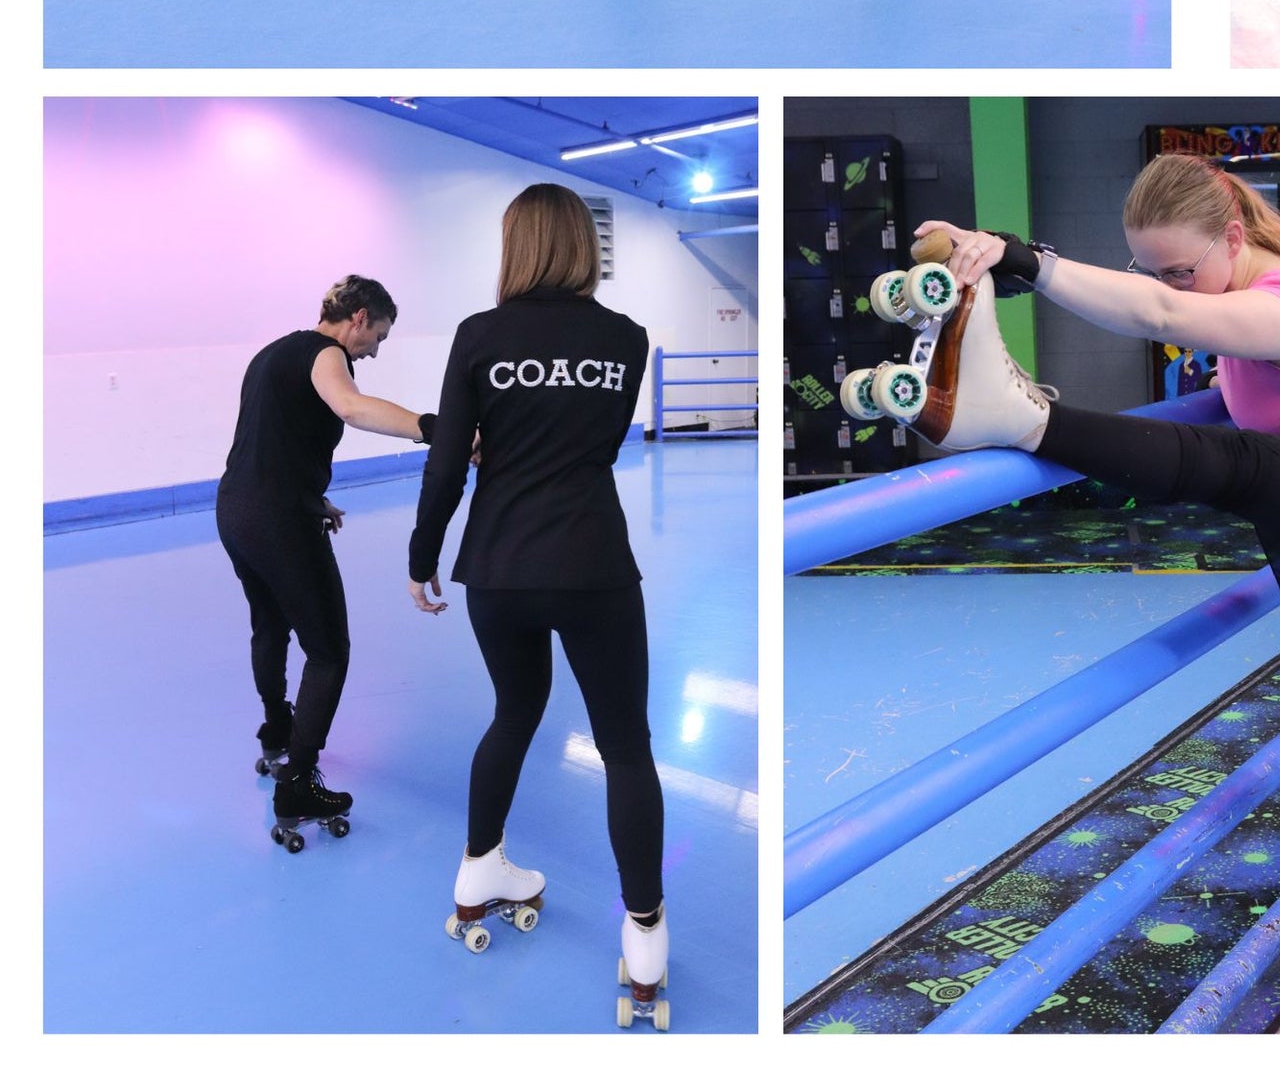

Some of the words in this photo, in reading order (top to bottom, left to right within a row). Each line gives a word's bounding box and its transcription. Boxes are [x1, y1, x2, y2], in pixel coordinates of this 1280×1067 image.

[1160, 132, 1233, 154] BLING
[489, 358, 626, 391] COACH
[801, 373, 835, 404] ROLLER
